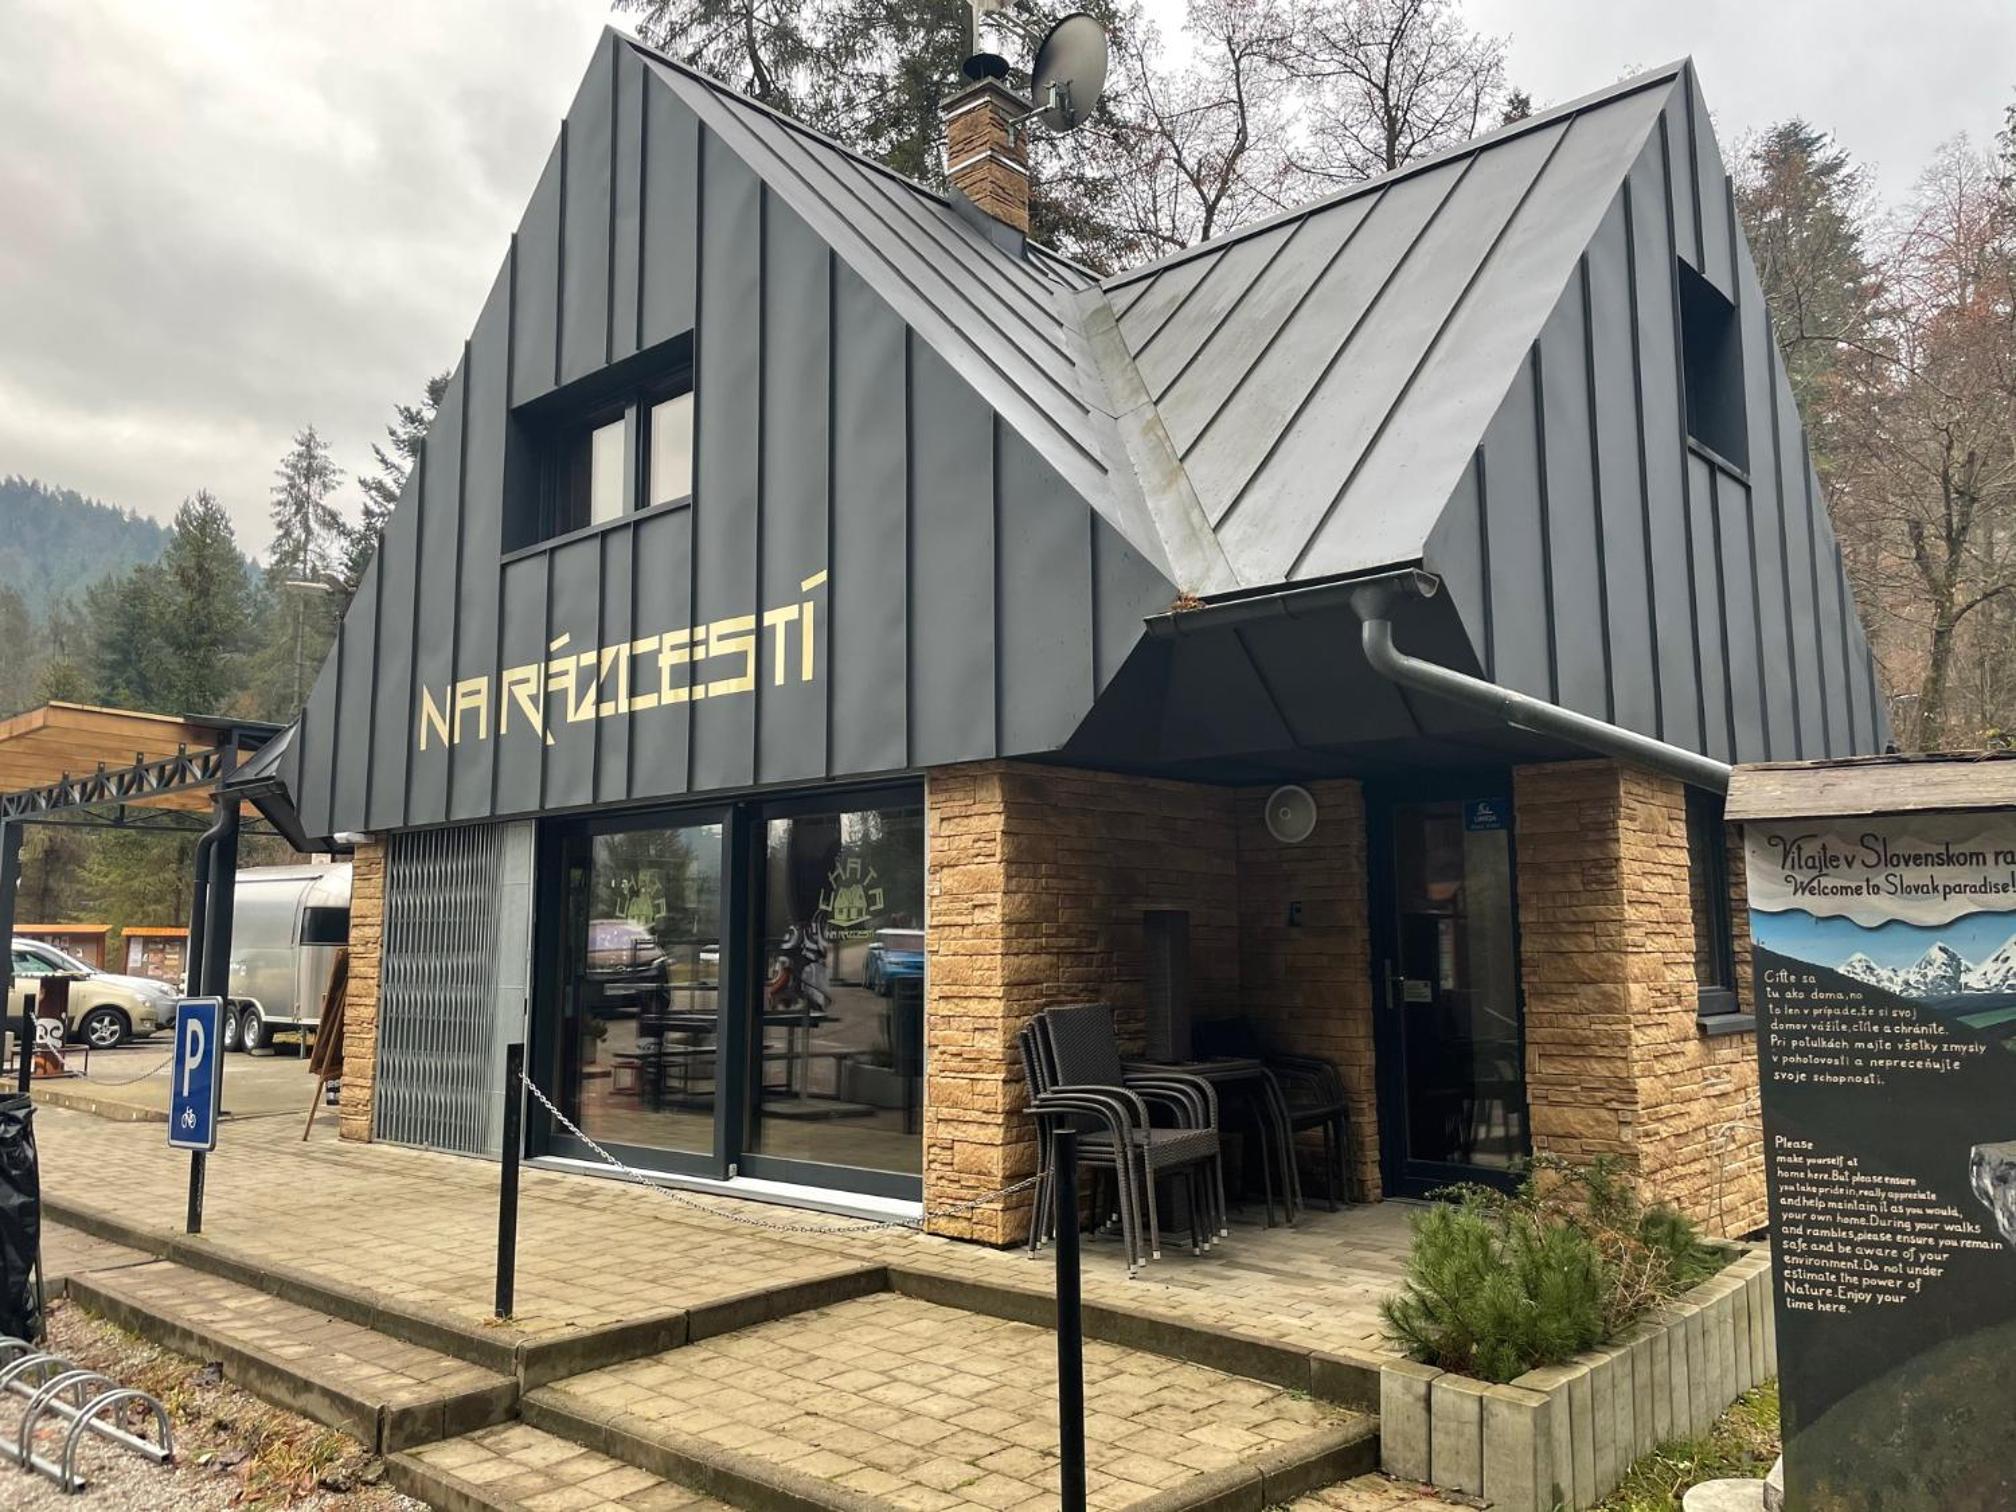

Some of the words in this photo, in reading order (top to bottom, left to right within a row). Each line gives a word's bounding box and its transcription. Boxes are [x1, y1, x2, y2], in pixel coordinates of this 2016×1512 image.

[420, 676, 488, 751] NA
[500, 569, 828, 746] RÁZCESTÍ
[1767, 834, 1840, 872] Vitajte
[1844, 854, 1856, 868] v
[1860, 833, 1987, 869] Slovenskom
[1785, 873, 1862, 896] Welcome
[1866, 877, 1880, 895] to
[1885, 873, 1940, 895] Slovak
[1943, 871, 2016, 900] paradise!
[1802, 974, 1816, 984] sa
[1766, 987, 1780, 998] tu
[1785, 987, 1805, 999] ako
[1769, 1004, 1781, 1014] to
[1784, 1004, 1800, 1015] len
[1879, 1006, 1888, 1017] si
[1892, 1008, 1917, 1020] svoj
[1770, 1018, 1808, 1030] domov
[1883, 1025, 1891, 1033] a
[1770, 1034, 1786, 1046] Pri
[1791, 1036, 1849, 1050] potulkách
[1854, 1037, 1892, 1052] majte
[1897, 1039, 1938, 1053] všetky
[1942, 1041, 1986, 1056] zmysly
[183, 1018, 205, 1097] P
[1782, 1053, 1849, 1066] pohotovosti
[1773, 1071, 1807, 1083] svoje
[1775, 1135, 1813, 1149] Please
[1776, 1153, 1804, 1163] make
[1806, 1155, 1844, 1168] yourself
[1847, 1157, 1858, 1166] at
[1777, 1166, 1805, 1178] home
[1851, 1171, 1883, 1186] please
[1884, 1175, 1917, 1186] ensure
[1779, 1184, 1795, 1192] you
[1796, 1182, 1817, 1192] take
[1818, 1185, 1845, 1196] pride
[1780, 1196, 1801, 1206] and
[1802, 1195, 1826, 1211] help
[1827, 1200, 1878, 1212] maintain
[1880, 1201, 1888, 1213] it
[1890, 1205, 1903, 1213] as
[1905, 1207, 1923, 1216] you
[1781, 1212, 1807, 1221] your
[1810, 1213, 1833, 1222] own
[1915, 1222, 1940, 1231] your
[1944, 1221, 1981, 1233] walks
[1781, 1224, 1803, 1235] and
[1896, 1233, 1935, 1245] ensure
[1939, 1239, 1958, 1249] you
[1960, 1240, 2003, 1250] remain
[1782, 1238, 1808, 1253] safe
[1810, 1241, 1834, 1252] and
[1838, 1242, 1852, 1253] be
[1855, 1246, 1898, 1258] aware
[1902, 1247, 1917, 1262] of
[1919, 1252, 1950, 1263] your
[1884, 1262, 1903, 1274] not
[1906, 1265, 1944, 1277] under
[1784, 1268, 1837, 1282] estimate
[1840, 1272, 1859, 1285] the
[1862, 1276, 1903, 1288] power
[1907, 1277, 1922, 1293] of
[1786, 1297, 1814, 1310] time
[1817, 1299, 1852, 1314] here.
[1876, 1292, 1907, 1305] your
